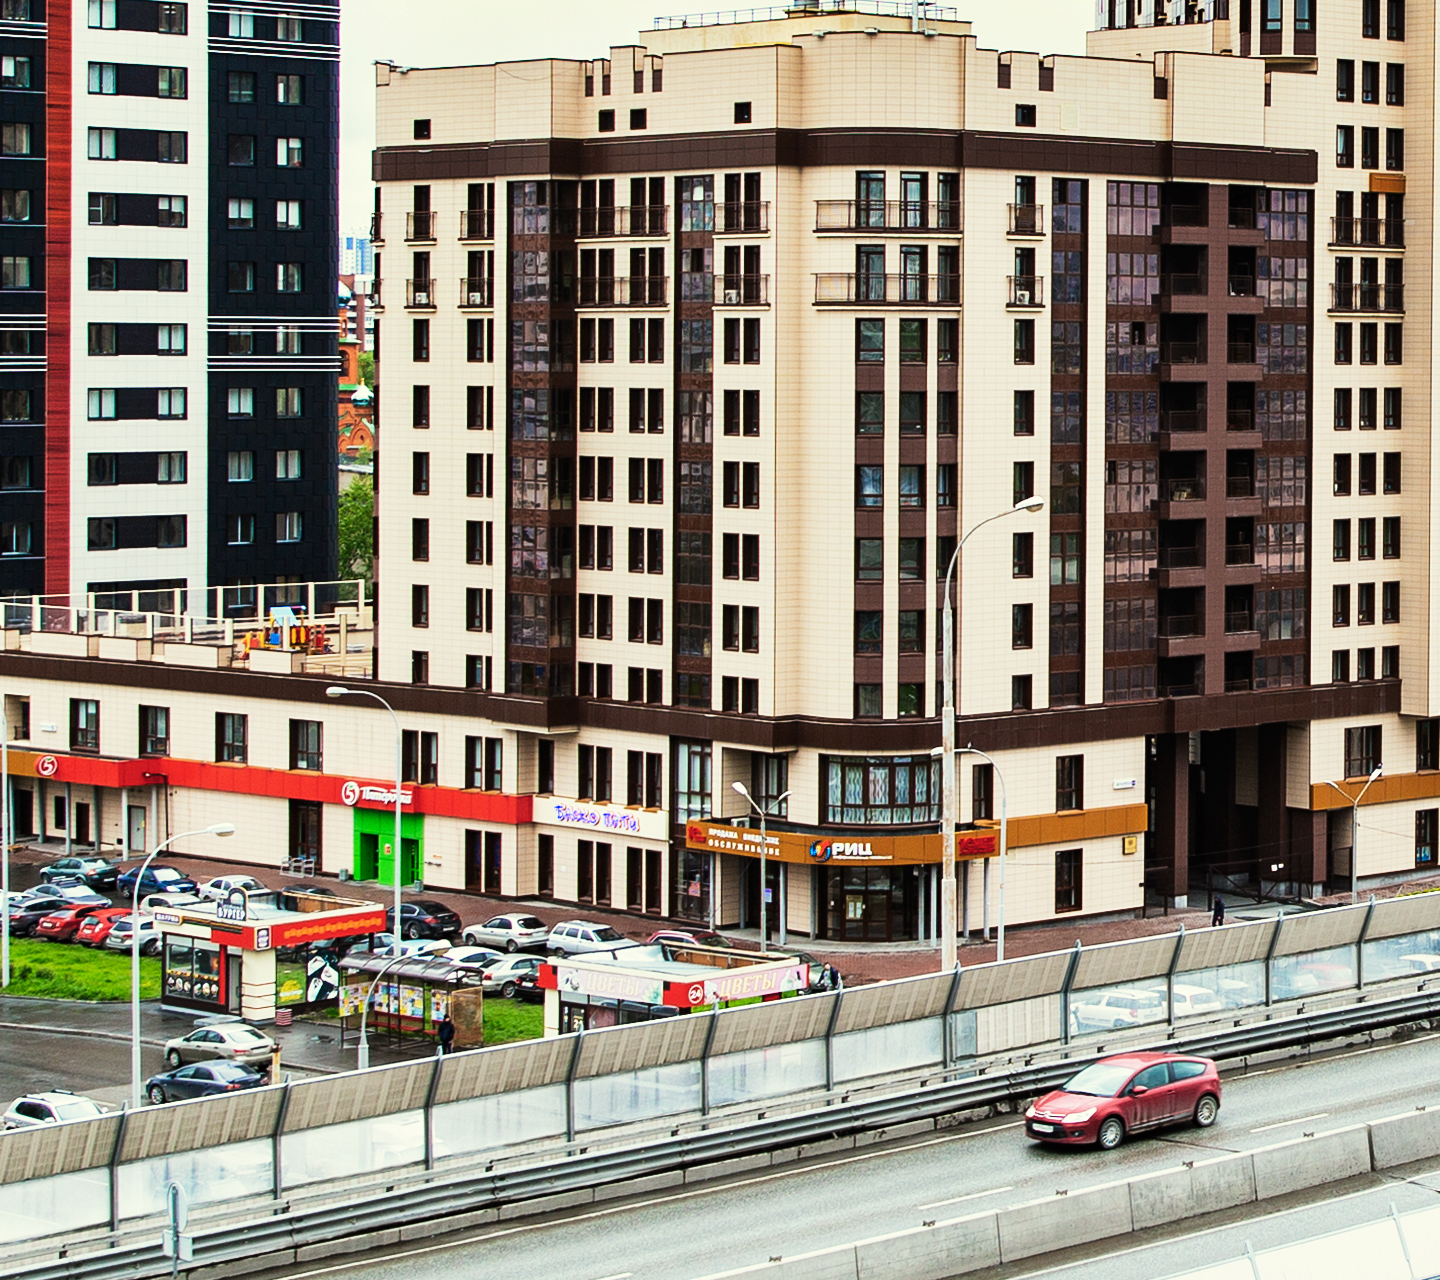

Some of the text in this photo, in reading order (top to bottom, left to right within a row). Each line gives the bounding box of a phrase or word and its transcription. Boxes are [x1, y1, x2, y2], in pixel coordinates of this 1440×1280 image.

[831, 842, 873, 856] РИЦ
[586, 973, 642, 997] ЦВЕТЫ
[719, 972, 777, 996] ЦВЕТЫ
